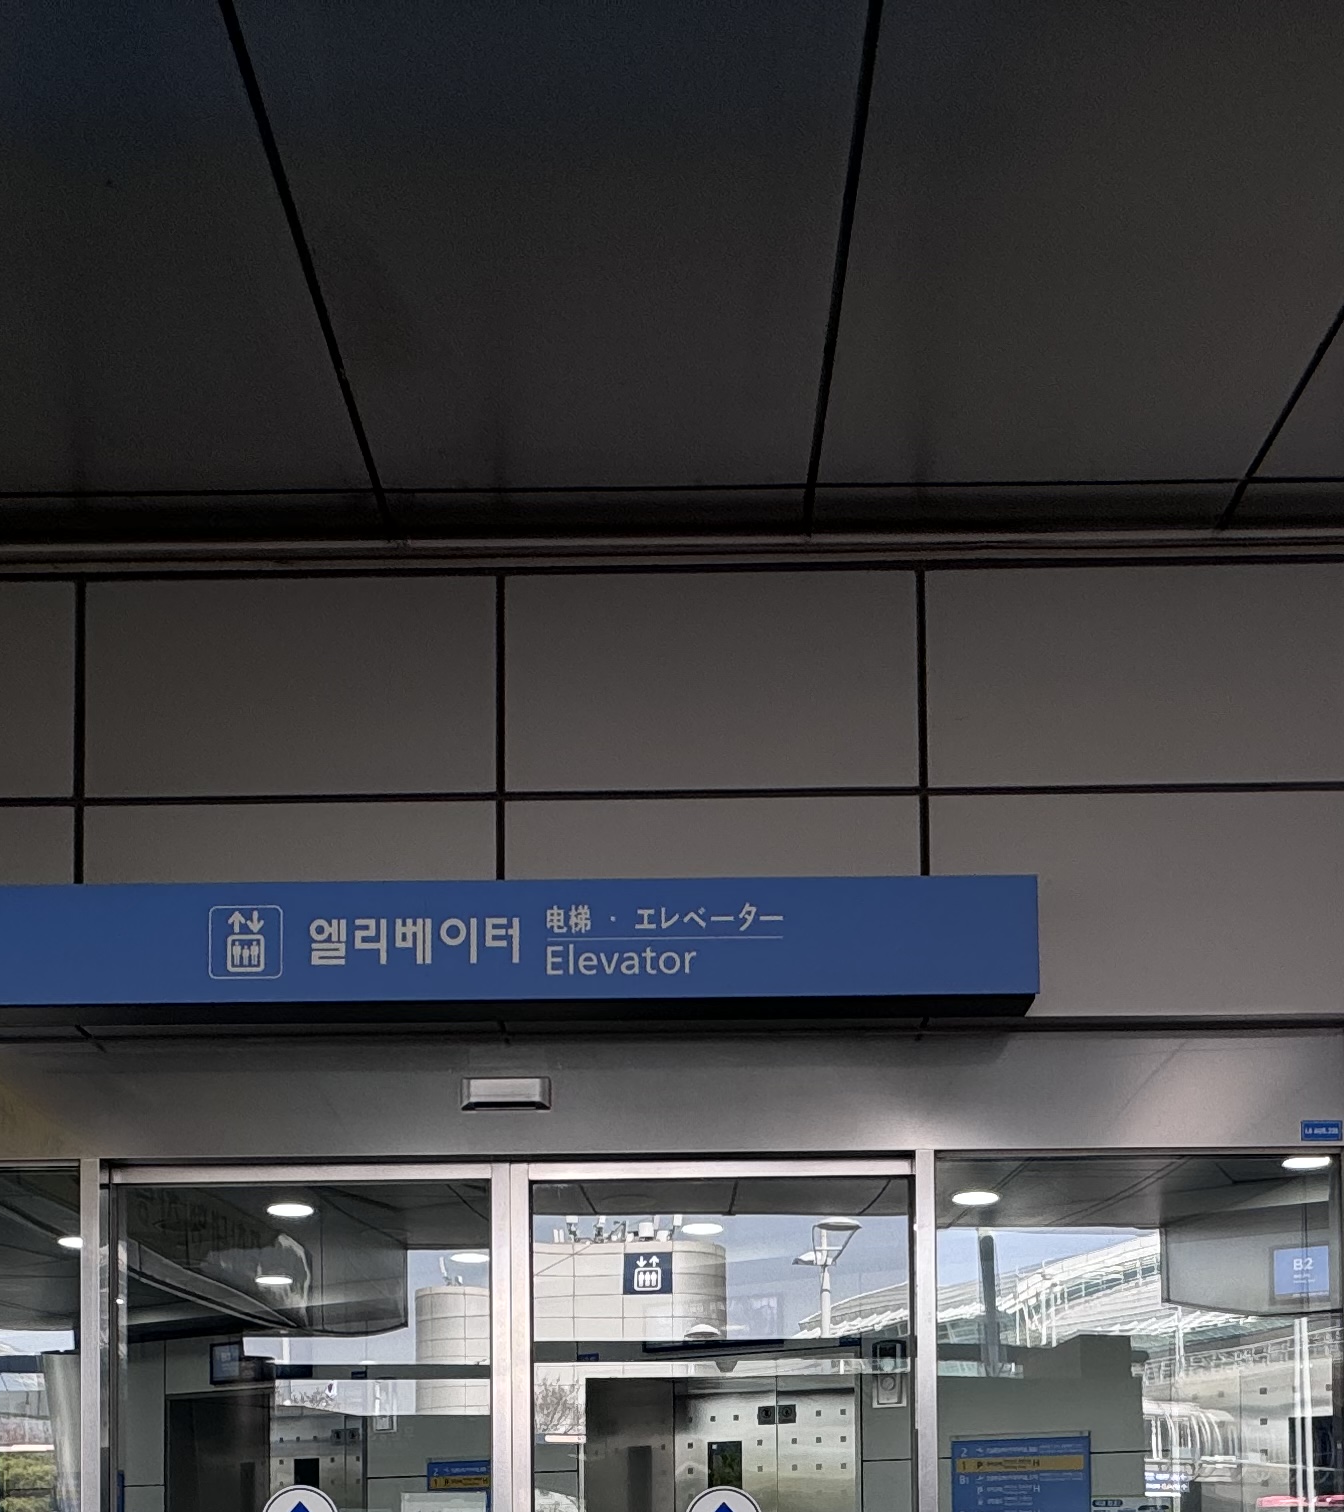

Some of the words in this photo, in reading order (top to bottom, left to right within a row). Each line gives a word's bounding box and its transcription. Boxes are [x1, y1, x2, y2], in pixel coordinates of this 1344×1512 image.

[545, 904, 592, 934] 电梯
[634, 902, 784, 931] エレベーター
[307, 915, 521, 966] 엘리베이터
[545, 943, 697, 976] Elevator
[1292, 1257, 1315, 1271] B2
